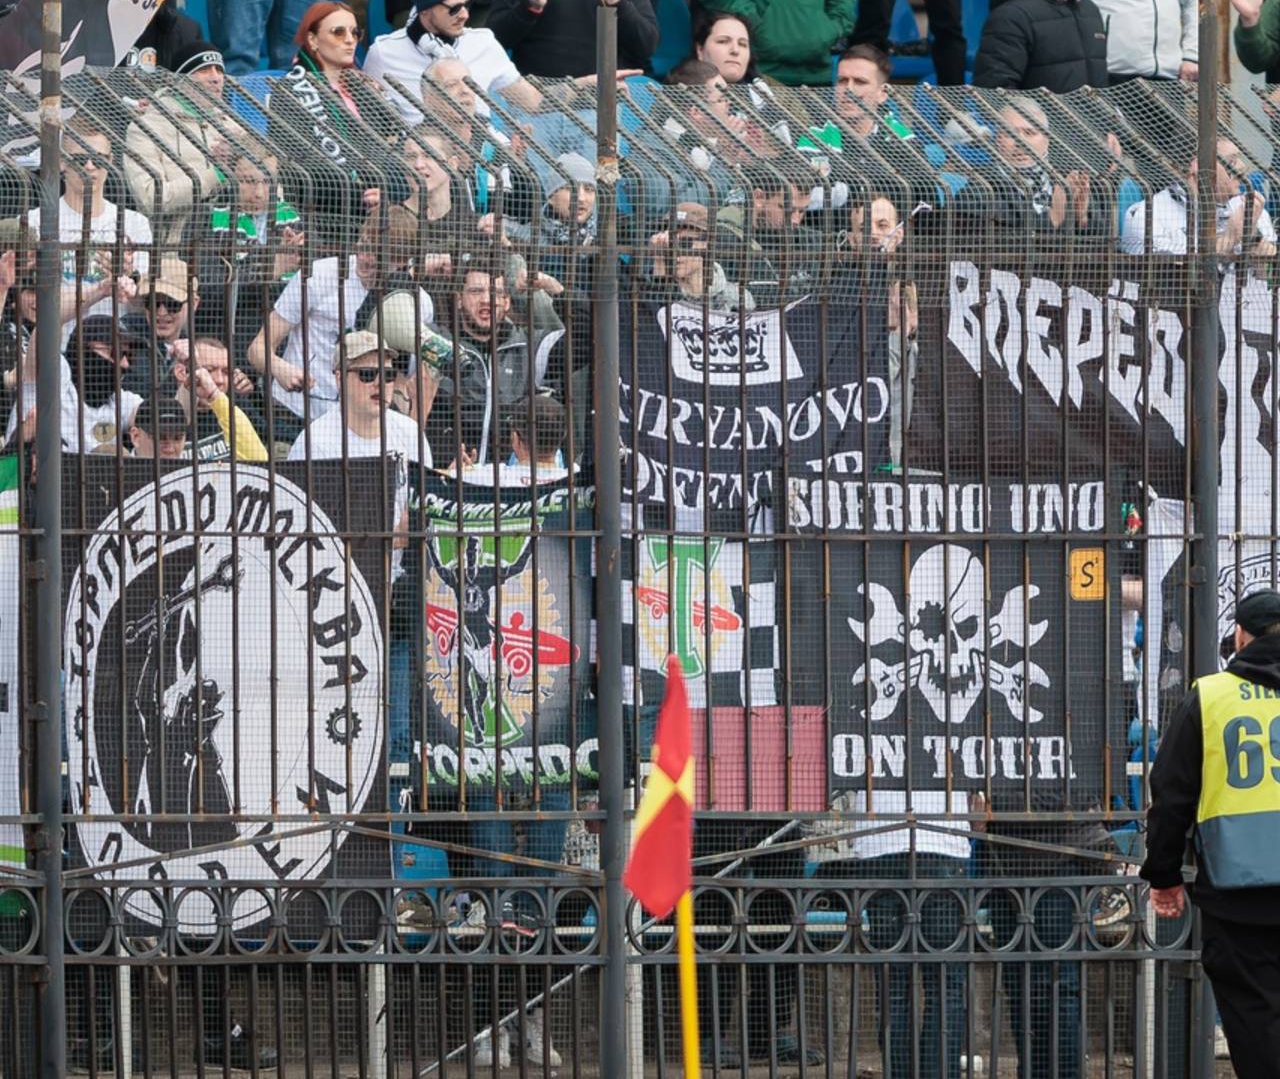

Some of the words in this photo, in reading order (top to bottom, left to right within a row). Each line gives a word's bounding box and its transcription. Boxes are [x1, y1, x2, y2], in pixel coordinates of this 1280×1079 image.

[619, 376, 890, 450] URYANOVO
[831, 733, 906, 779] ON
[923, 735, 1078, 780] TOUR
